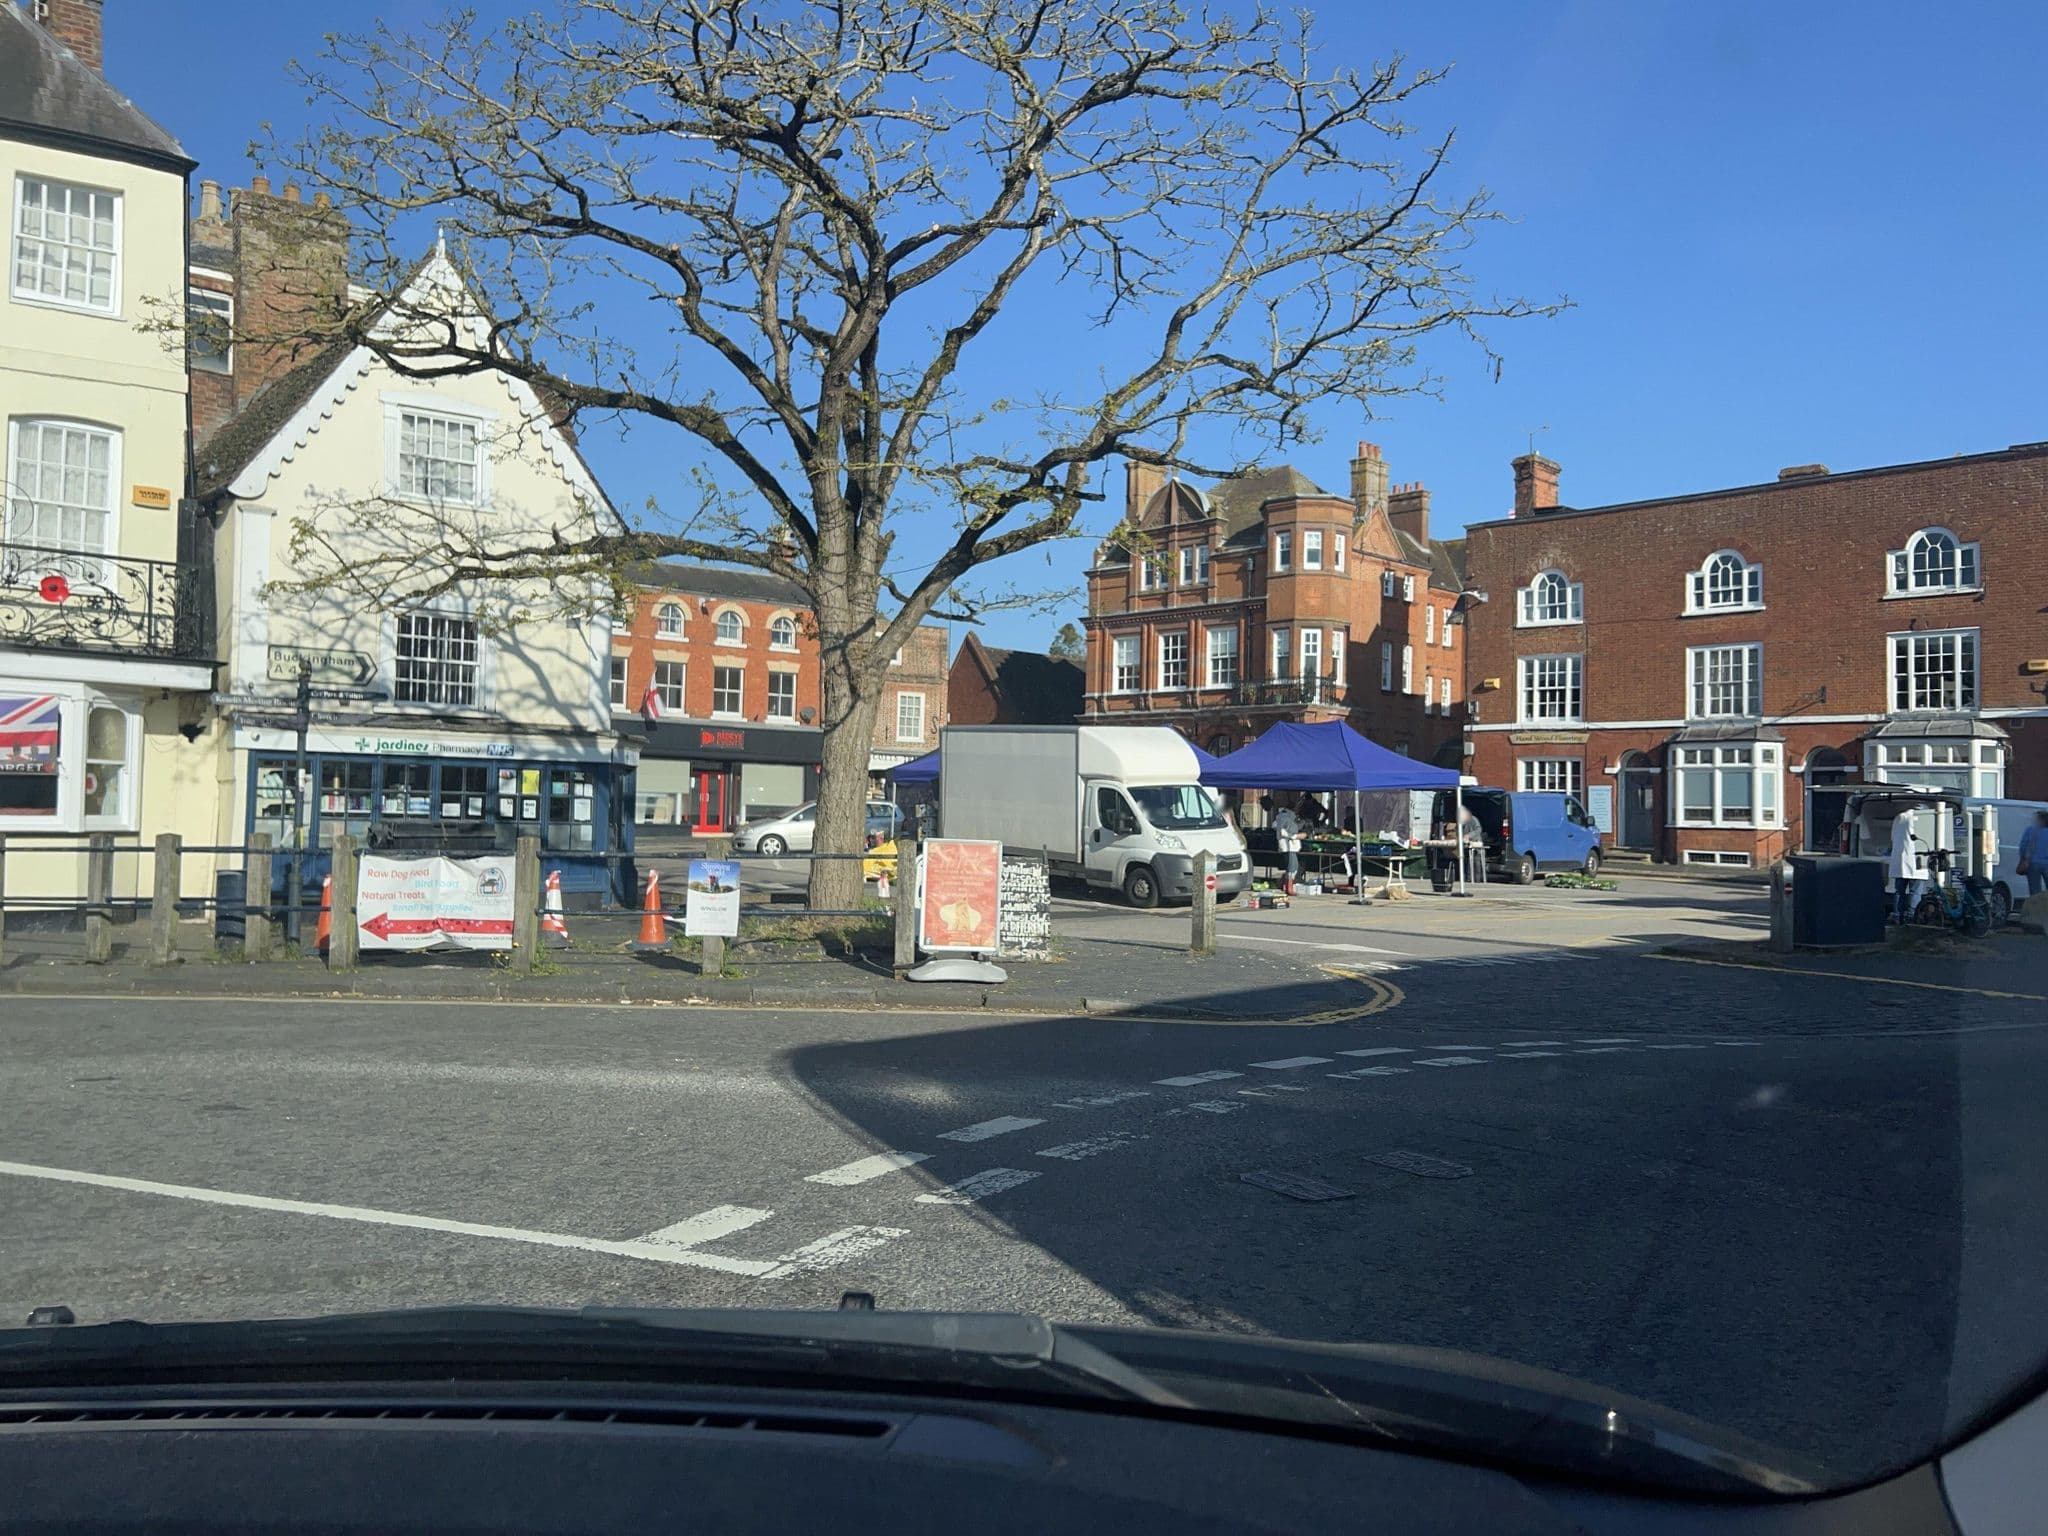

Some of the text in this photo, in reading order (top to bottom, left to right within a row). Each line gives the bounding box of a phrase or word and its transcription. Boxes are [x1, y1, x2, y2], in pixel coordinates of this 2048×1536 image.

[274, 663, 283, 674] A
[375, 738, 513, 756] jardines Pharmacy NHS
[367, 868, 388, 878] Raw
[391, 869, 409, 880] Dog
[415, 879, 459, 889] Bird Food
[361, 891, 426, 900] Natural Treats
[392, 903, 473, 914] Small Pet Supplies
